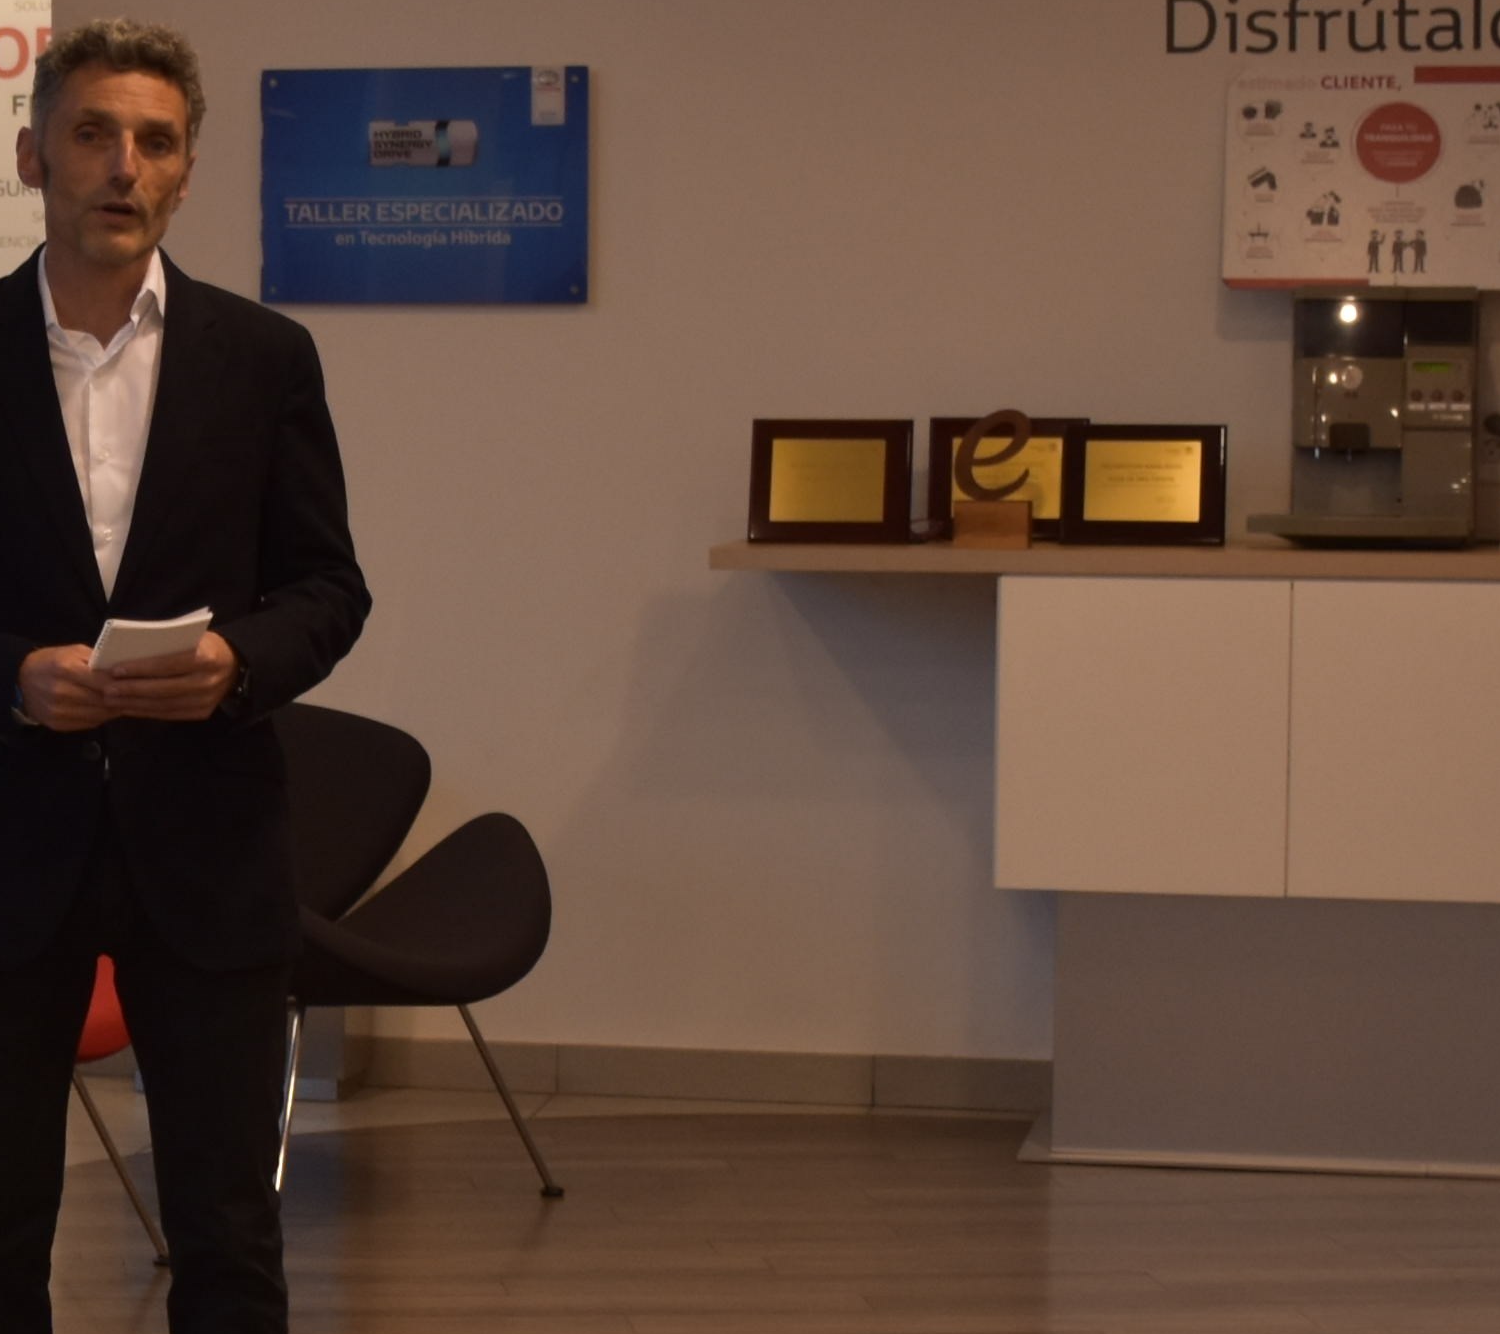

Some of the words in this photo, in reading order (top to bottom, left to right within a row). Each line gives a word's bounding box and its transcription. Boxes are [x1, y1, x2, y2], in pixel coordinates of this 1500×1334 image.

[1320, 74, 1403, 93] CLIENTE,
[373, 129, 423, 139] HYBRID
[373, 139, 433, 149] SYNERGY
[373, 149, 412, 159] DRIVE
[284, 201, 371, 223] TALLER
[375, 200, 565, 223] ESPECIALIZADO
[335, 234, 355, 246] en
[450, 229, 512, 246] Híbrida
